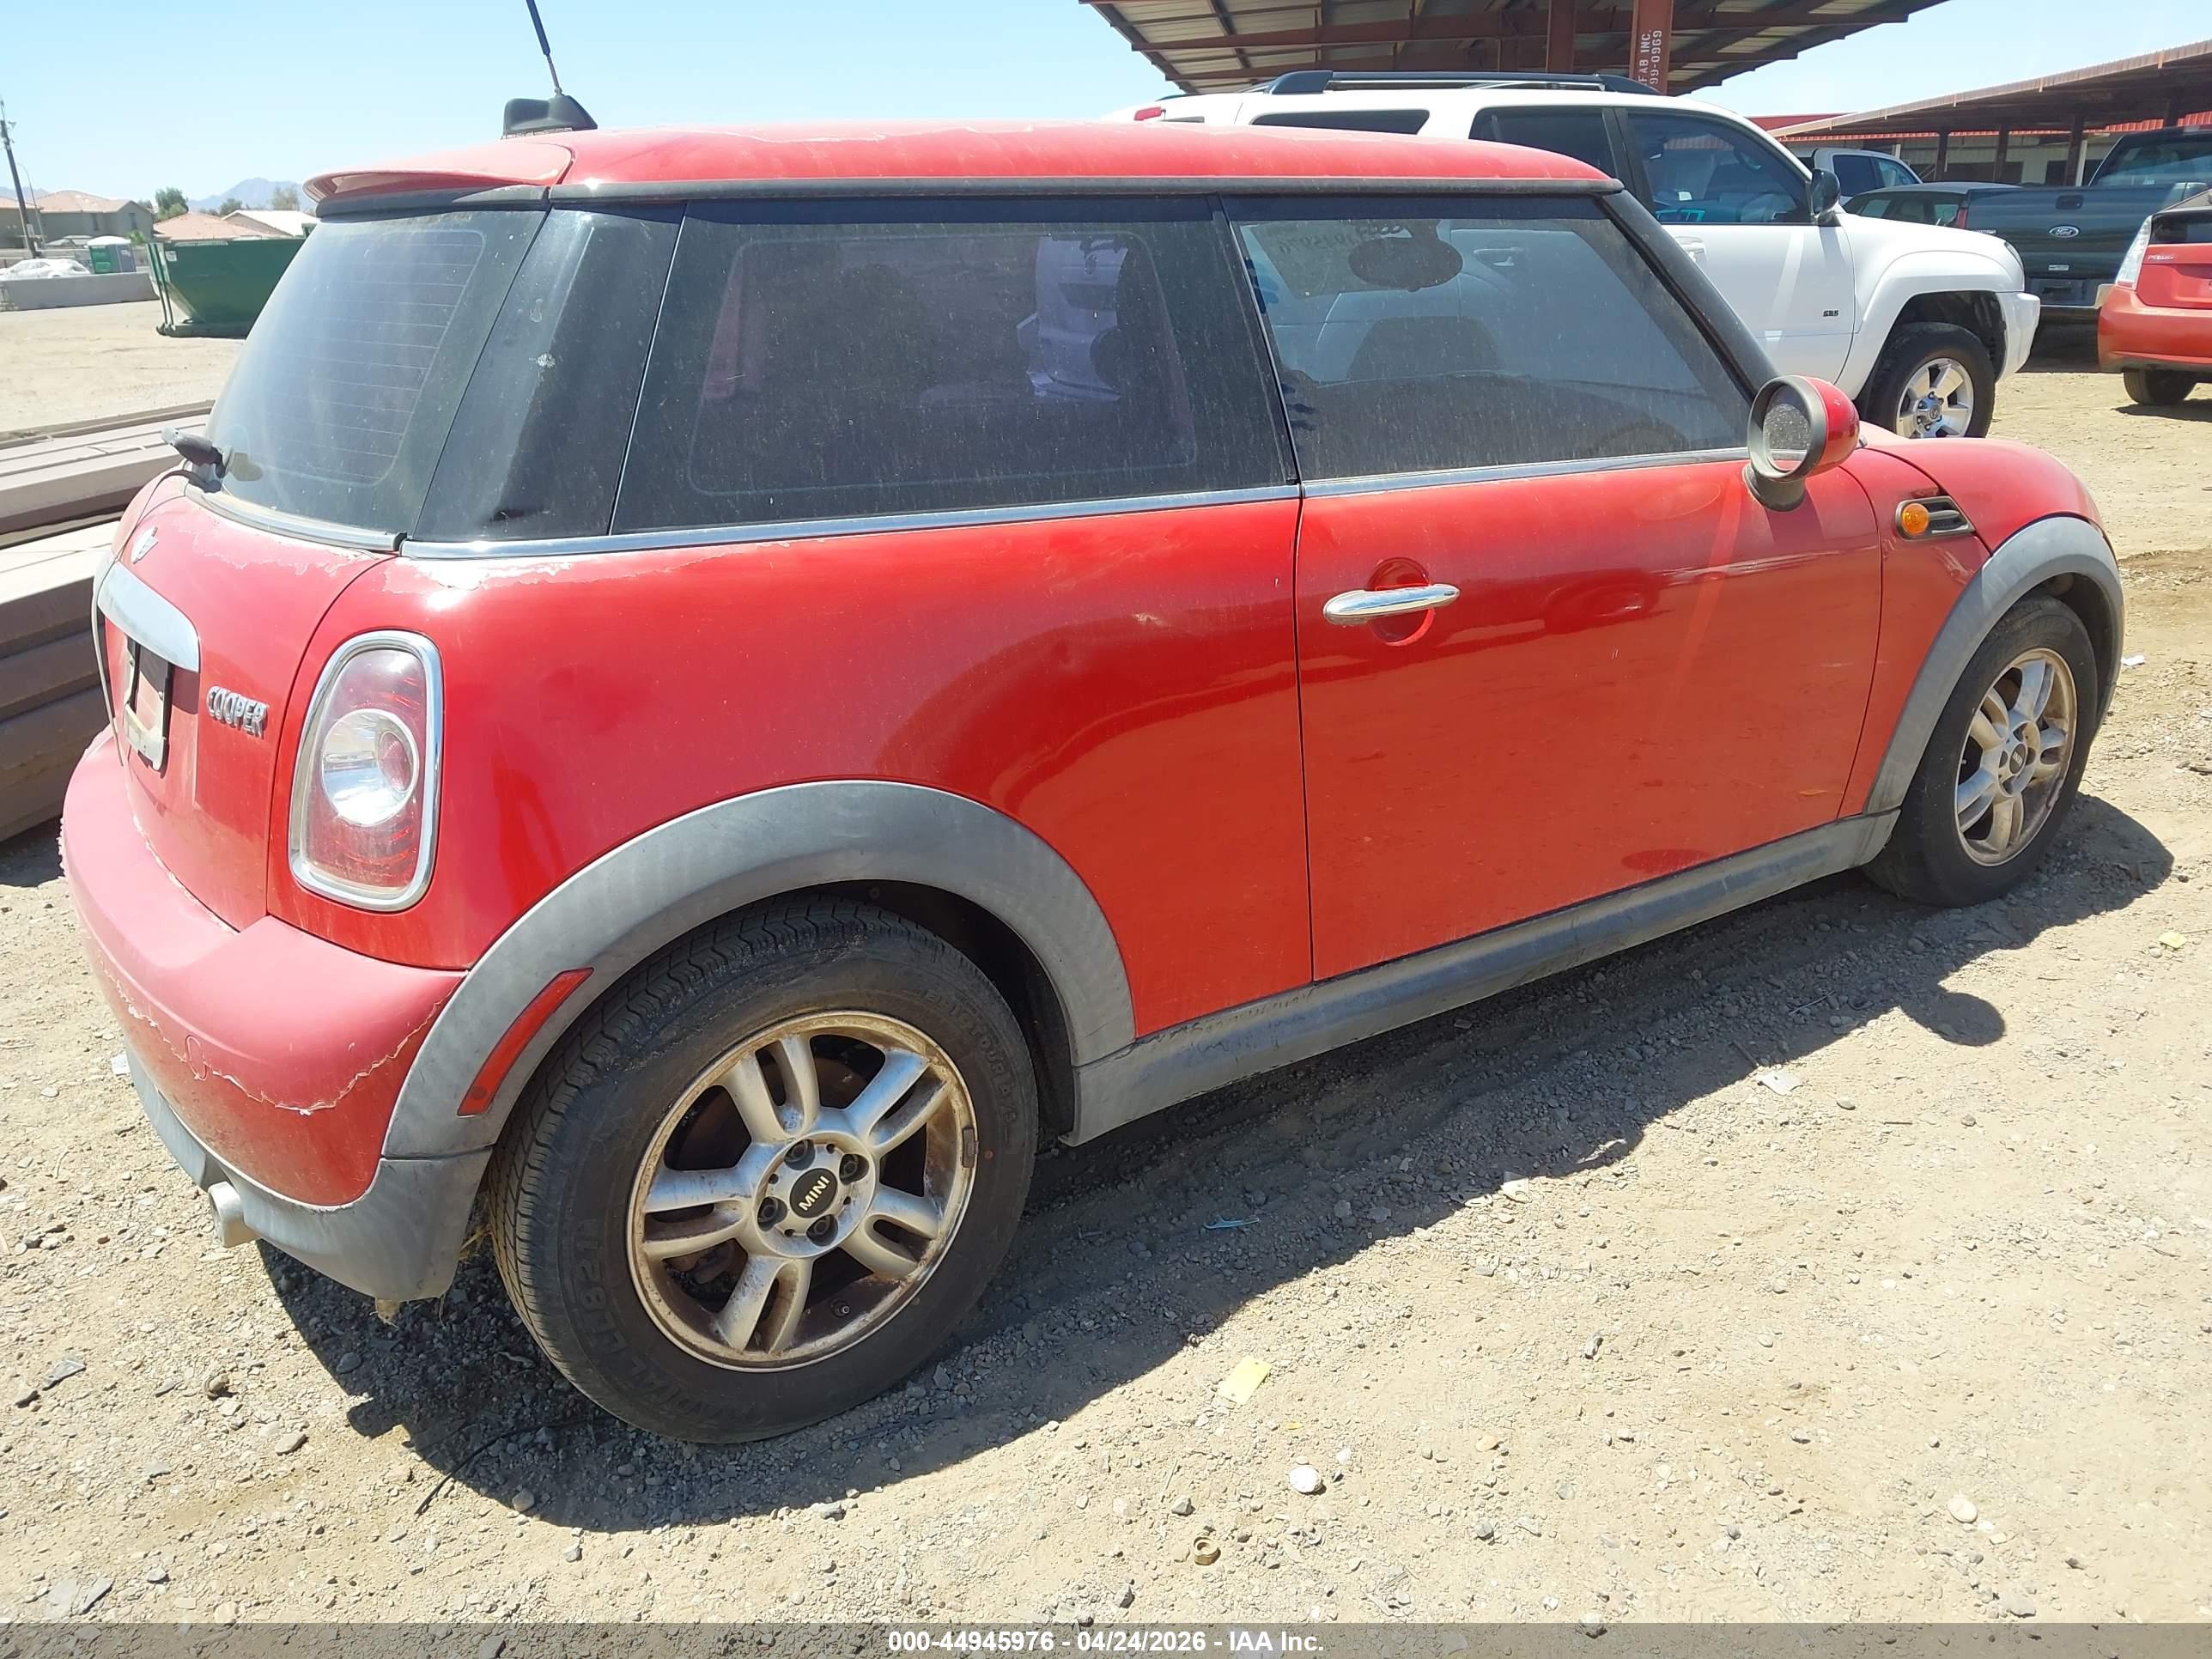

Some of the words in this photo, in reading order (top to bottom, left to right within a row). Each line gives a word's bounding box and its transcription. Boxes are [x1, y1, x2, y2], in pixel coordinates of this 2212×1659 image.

[1640, 29, 1651, 53] INC.
[1638, 59, 1649, 82] FAB
[207, 685, 269, 738] COOPER
[799, 1176, 830, 1211] MINI
